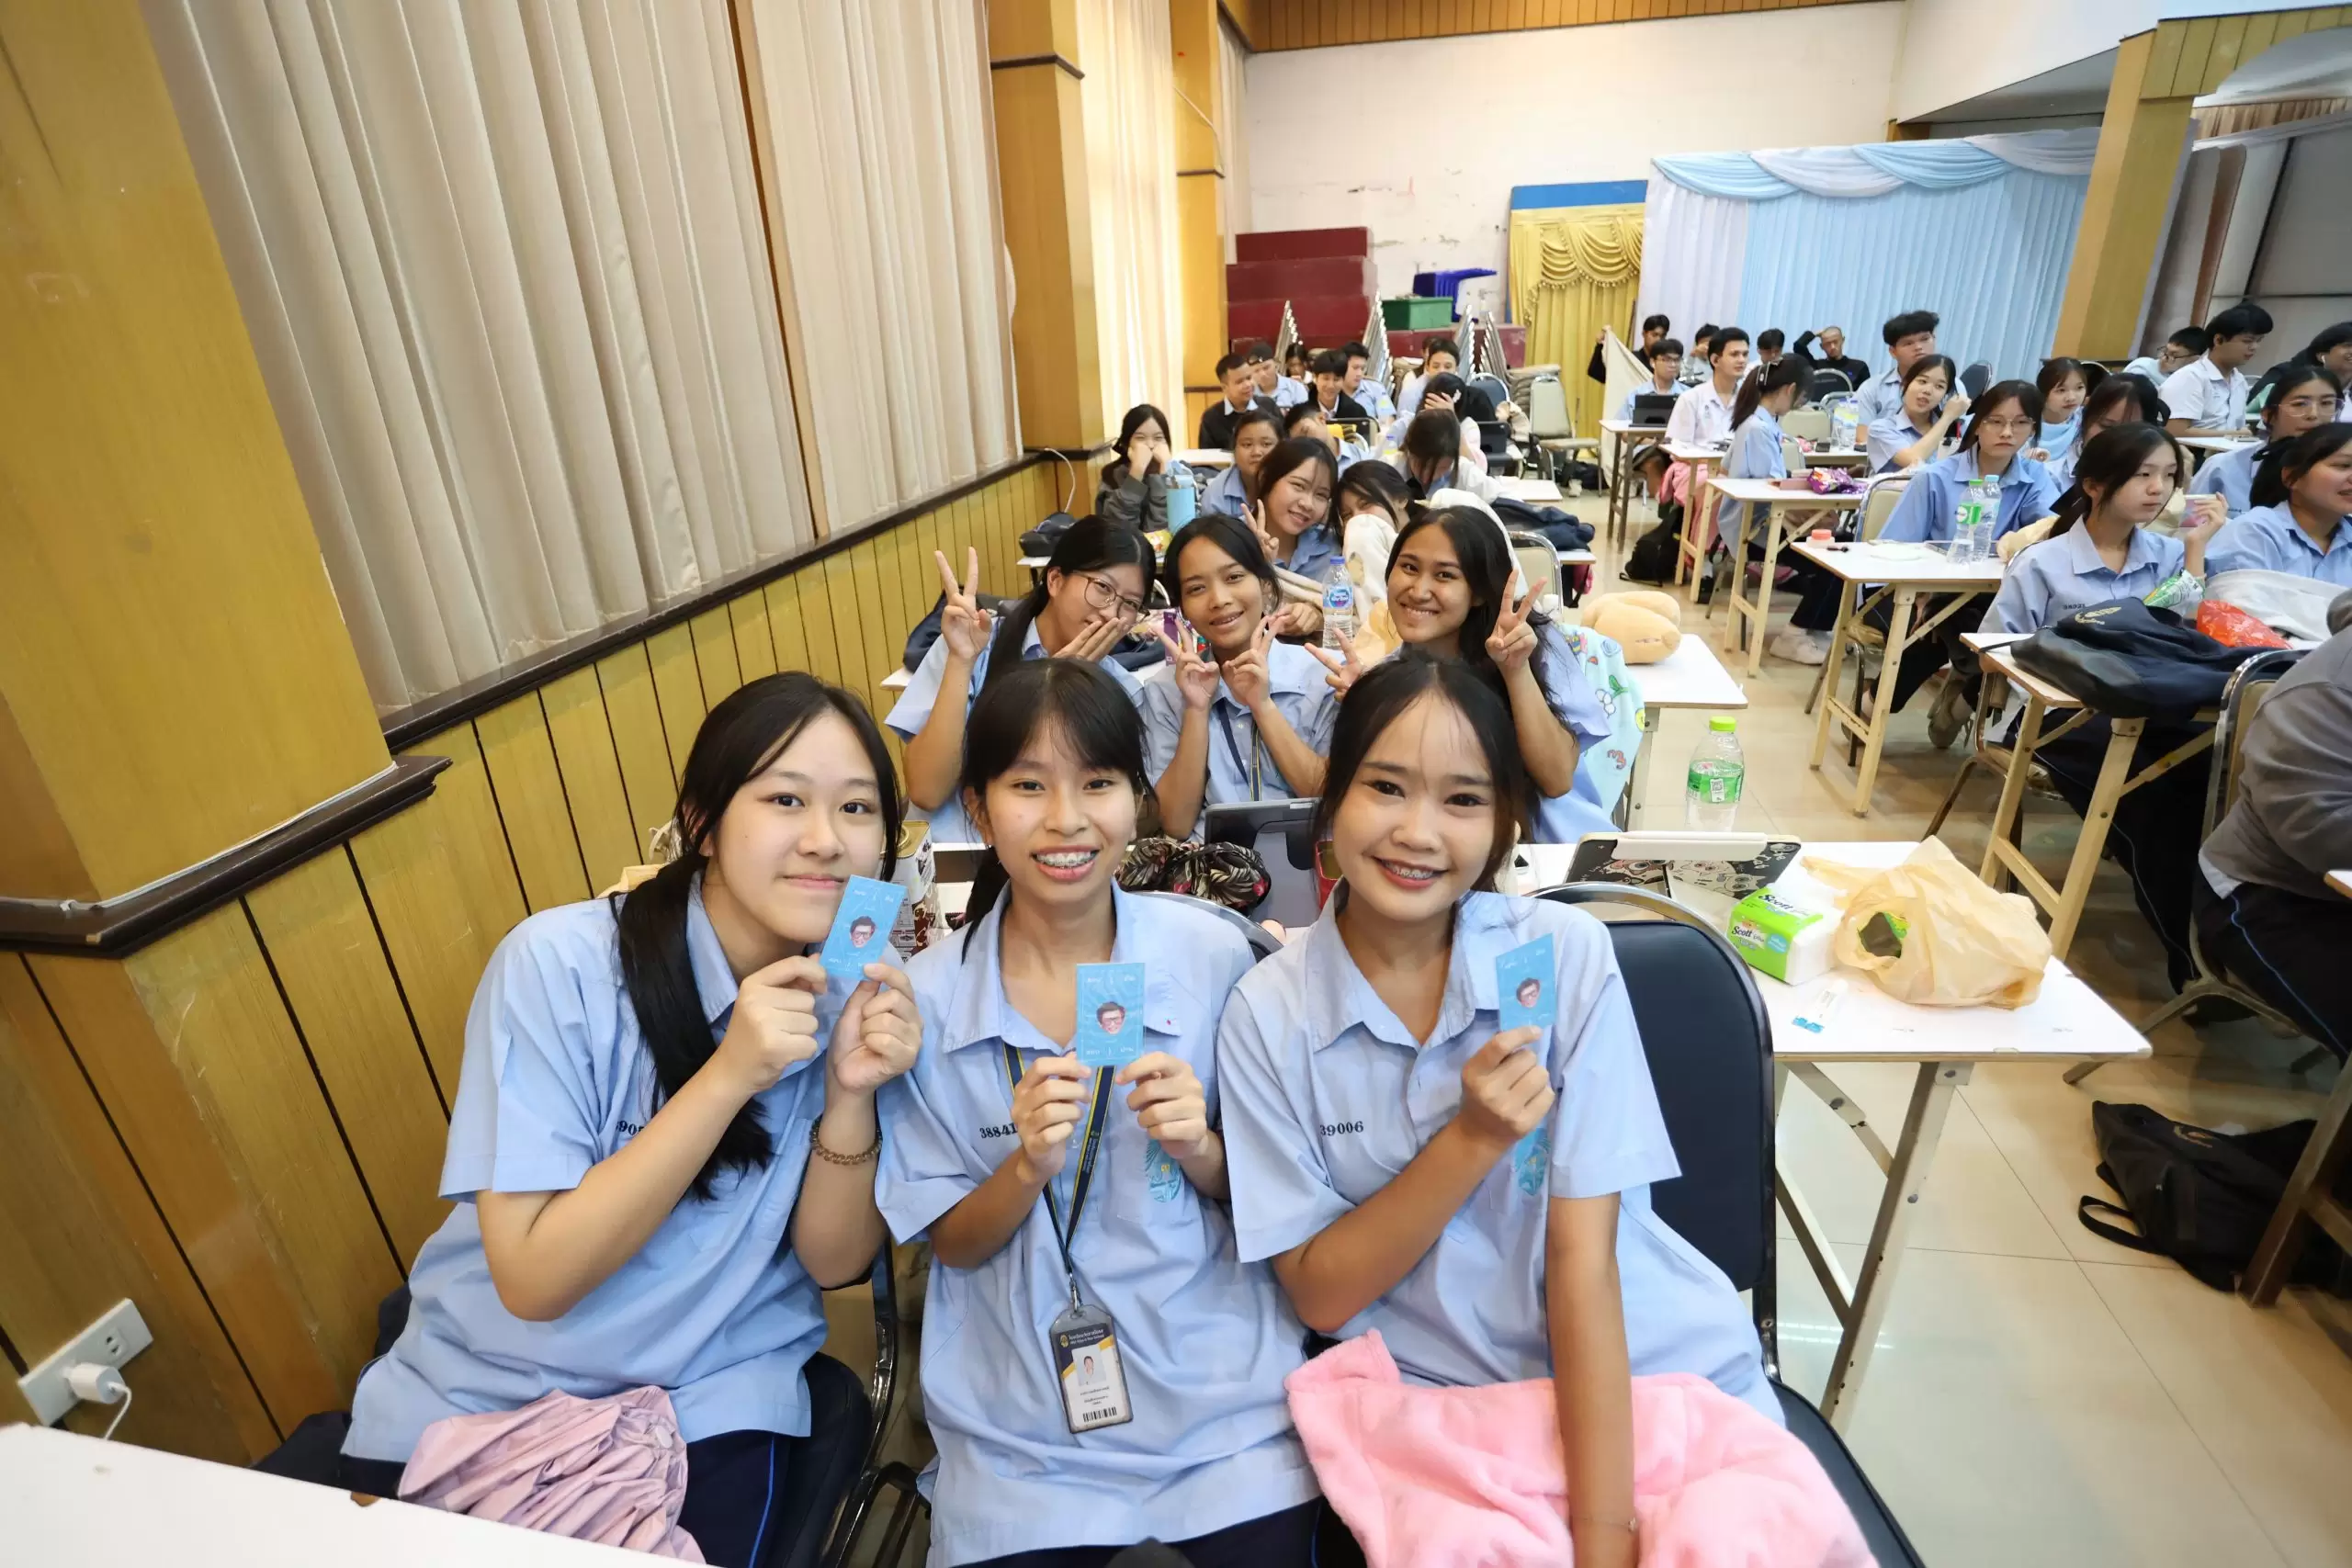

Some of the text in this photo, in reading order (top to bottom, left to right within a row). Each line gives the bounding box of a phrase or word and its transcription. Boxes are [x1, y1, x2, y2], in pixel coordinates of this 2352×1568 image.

[1758, 895, 1793, 909] Scott
[1732, 925, 1752, 938] Scott
[979, 1122, 1018, 1138] 38841
[1319, 1121, 1364, 1136] 39006
